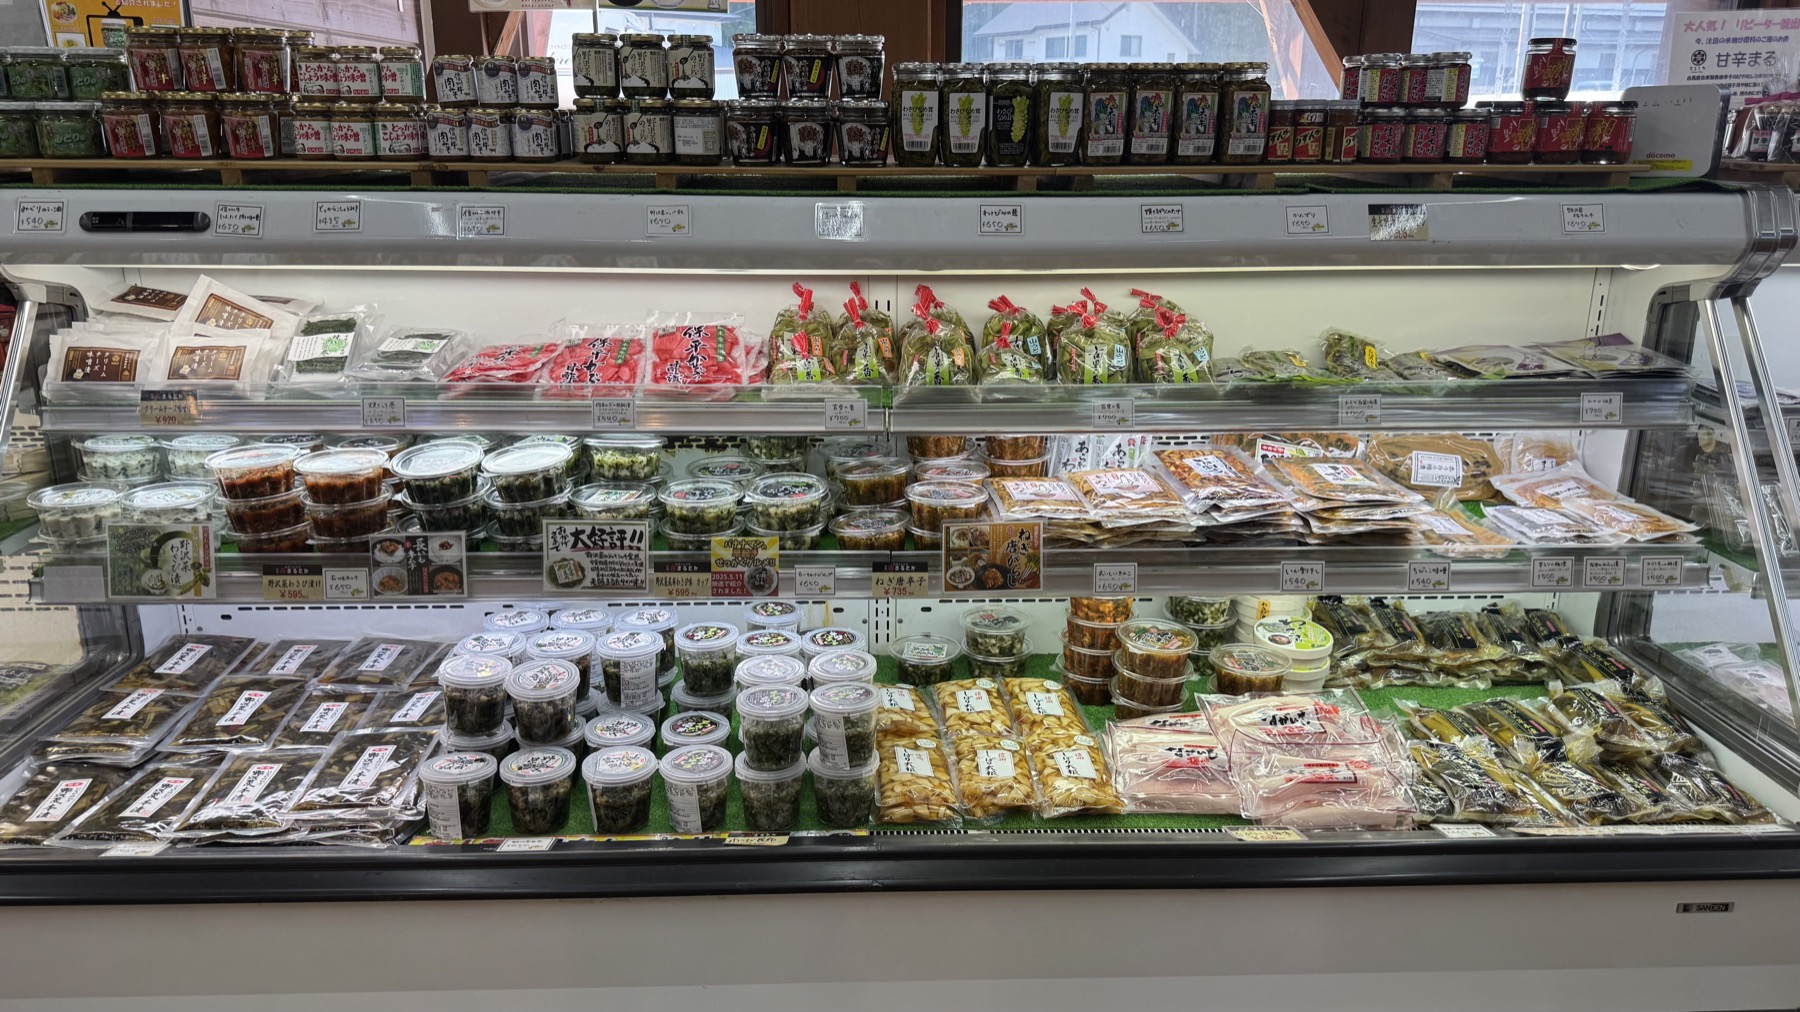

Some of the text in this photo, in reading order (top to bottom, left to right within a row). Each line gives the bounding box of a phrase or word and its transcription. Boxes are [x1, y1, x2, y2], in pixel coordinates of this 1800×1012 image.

[1716, 51, 1777, 68] 甘辛まる
[21, 217, 43, 226] ¥540
[319, 216, 340, 225] ¥435
[983, 221, 1003, 229] ¥650
[155, 416, 177, 424] ¥920
[570, 525, 644, 551] 大好評!!
[1018, 527, 1031, 556] ねぎ
[724, 538, 767, 550] バナナマンの
[179, 539, 191, 574] 野沢菜
[170, 544, 181, 585] わさび漬
[1007, 539, 1021, 588] 唐がらし
[268, 579, 321, 588] 野沢菜わさび漬け
[696, 577, 710, 587] カップ
[876, 575, 926, 587] ねぎ唐辛子
[1285, 577, 1306, 585] ¥540
[1411, 577, 1431, 585] ¥540
[280, 590, 303, 599] ¥595
[668, 588, 690, 596] ¥595
[884, 587, 907, 596] ¥735
